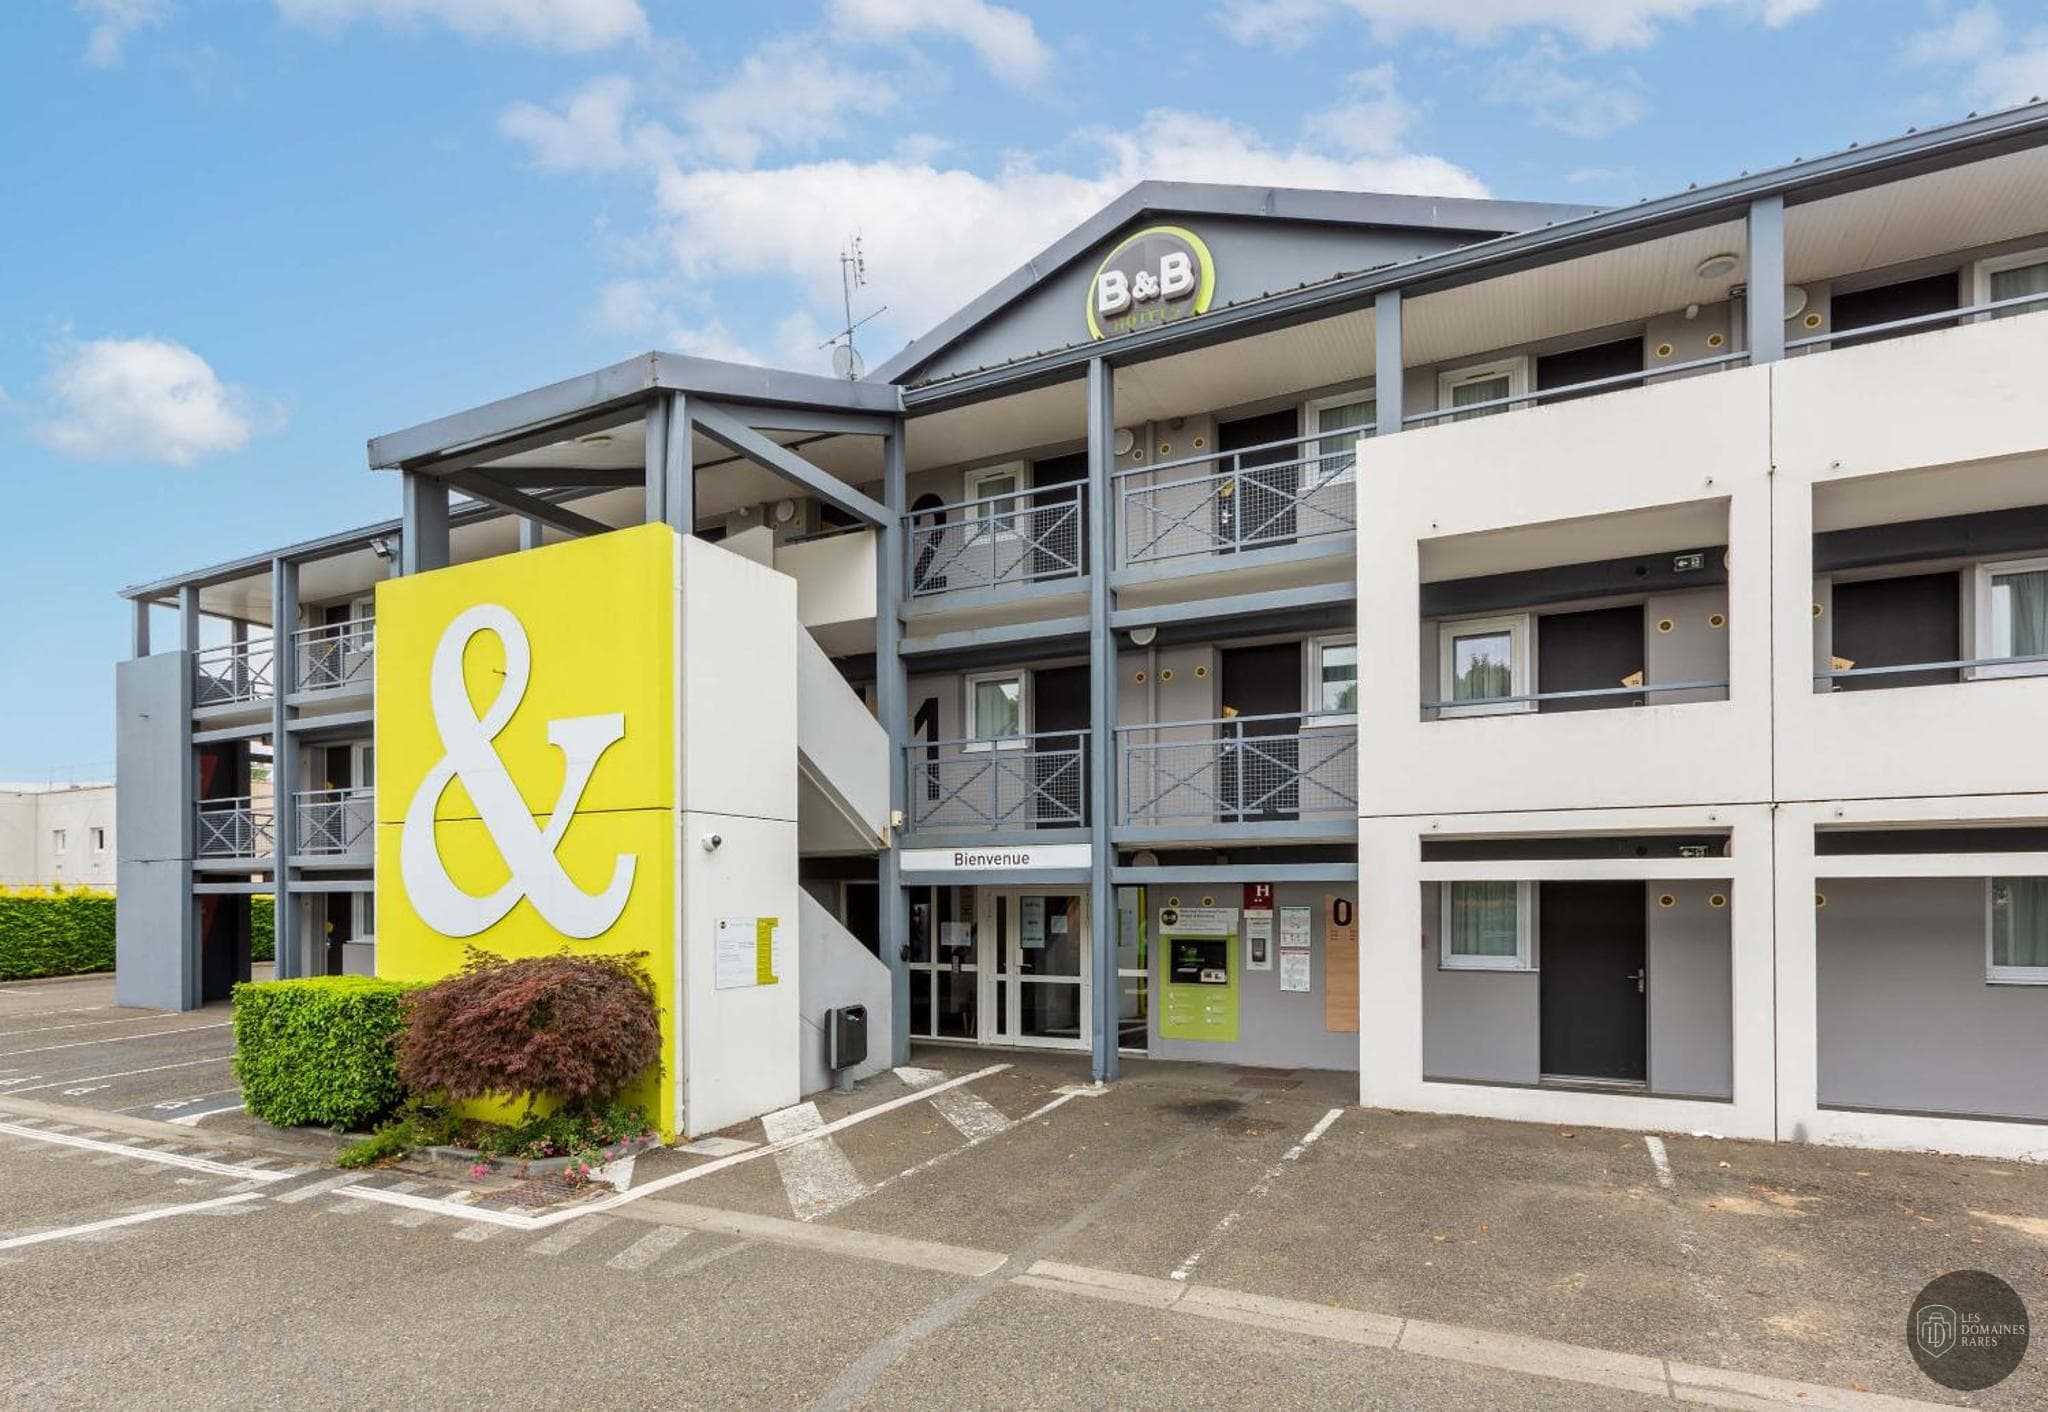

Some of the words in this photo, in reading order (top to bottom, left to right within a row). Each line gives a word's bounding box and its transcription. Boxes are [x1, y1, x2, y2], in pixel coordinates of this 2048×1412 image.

[1098, 252, 1195, 317] B&B
[400, 602, 639, 940] &
[914, 697, 940, 801] 1
[954, 852, 1030, 867] Bienvenue
[1256, 884, 1270, 897] H
